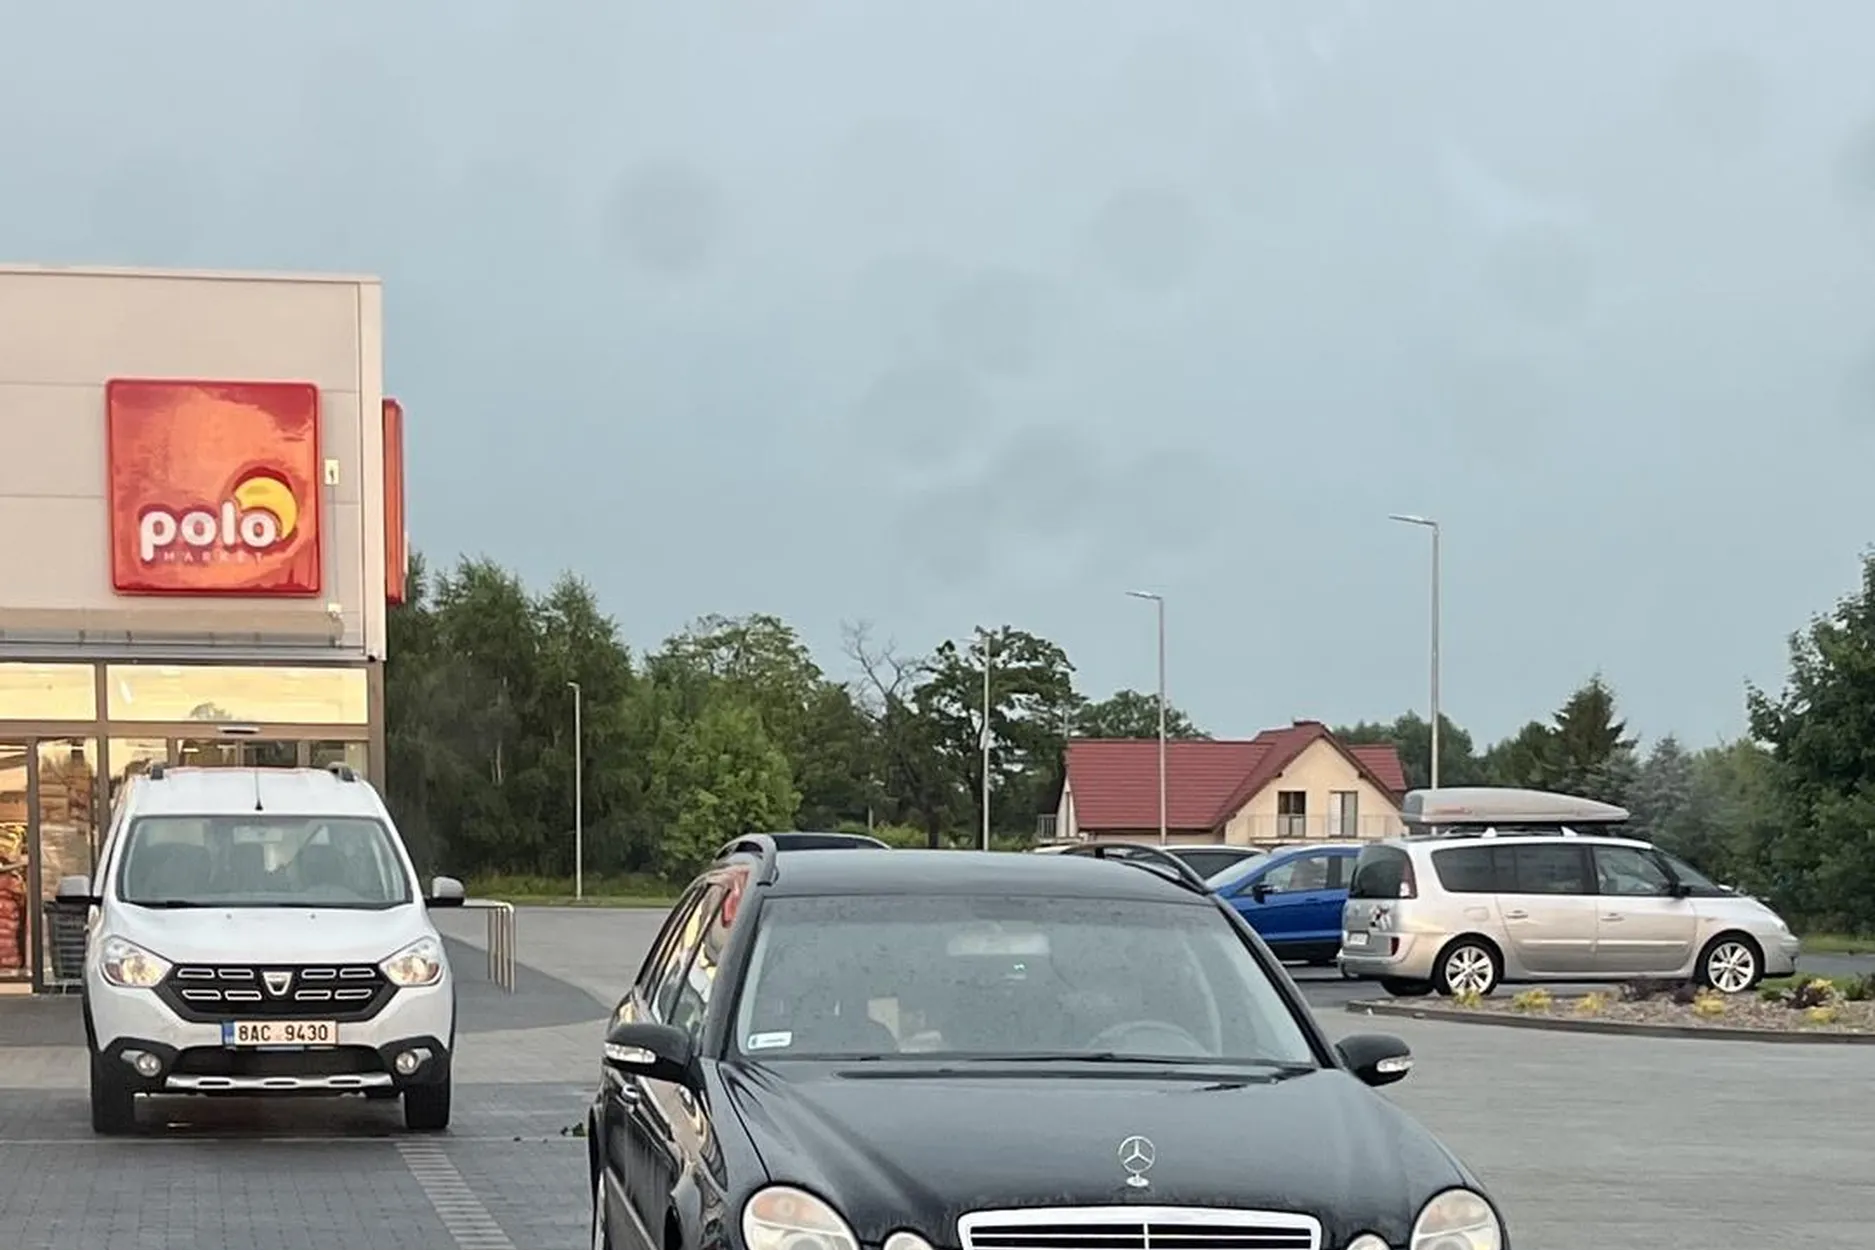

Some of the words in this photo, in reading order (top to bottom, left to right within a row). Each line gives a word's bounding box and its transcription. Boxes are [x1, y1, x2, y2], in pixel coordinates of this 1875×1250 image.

[140, 500, 277, 562] polo
[238, 1024, 271, 1042] 8AC
[284, 1024, 328, 1042] 9430
